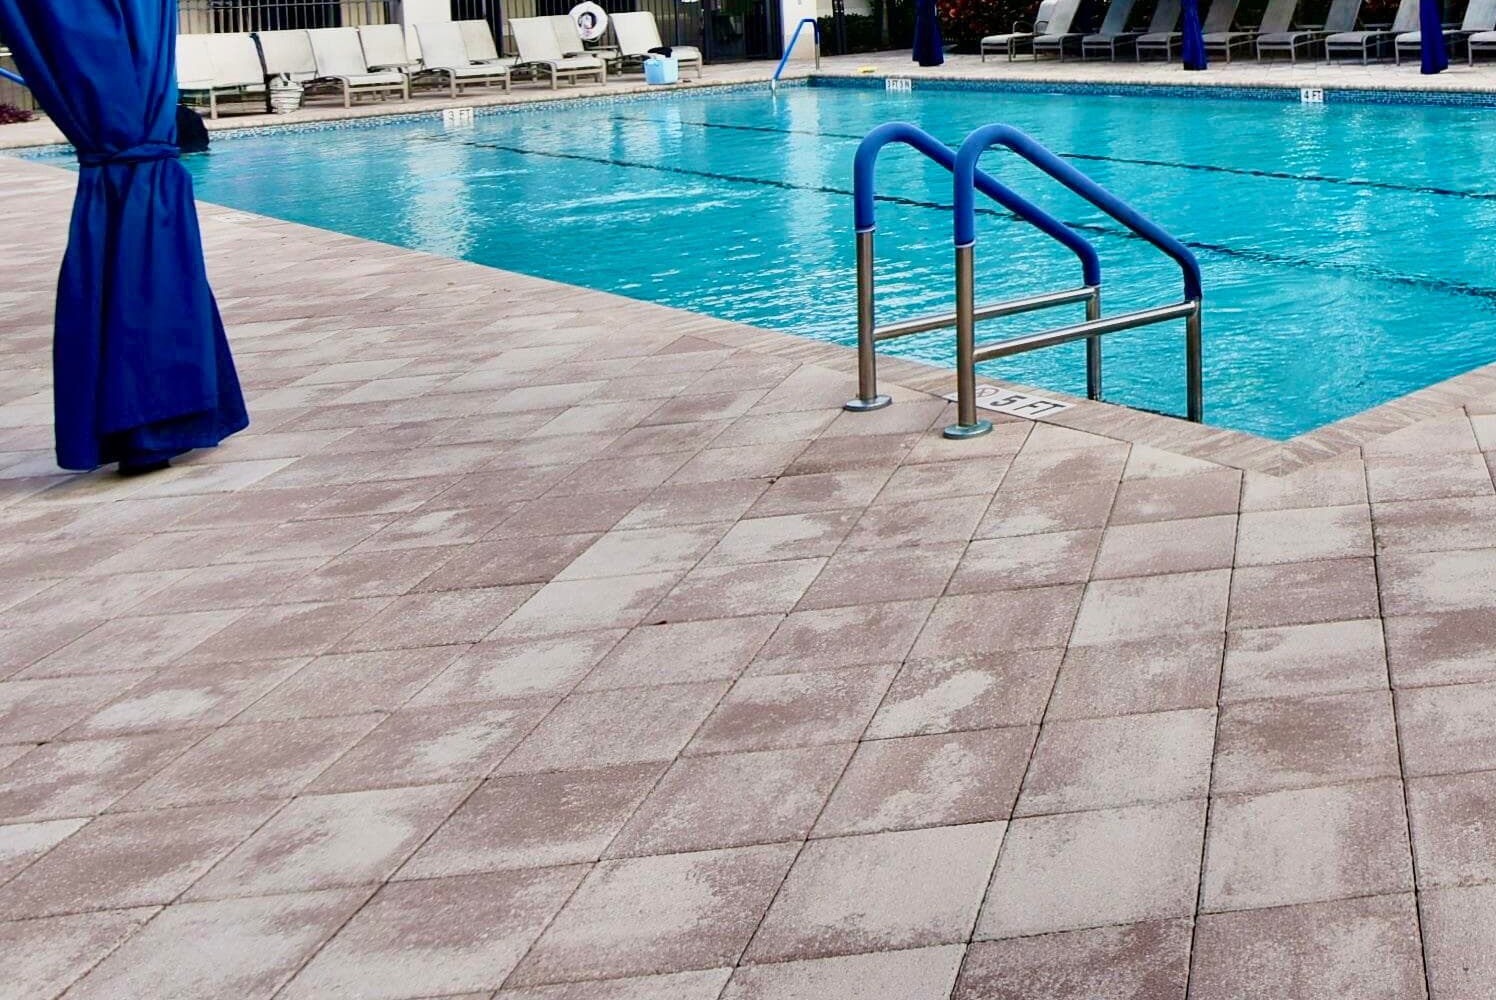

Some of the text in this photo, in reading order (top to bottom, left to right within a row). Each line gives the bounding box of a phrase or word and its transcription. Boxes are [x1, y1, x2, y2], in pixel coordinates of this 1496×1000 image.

[1312, 90, 1321, 101] FT
[459, 109, 470, 121] FT
[990, 395, 1067, 415] 5 FT
